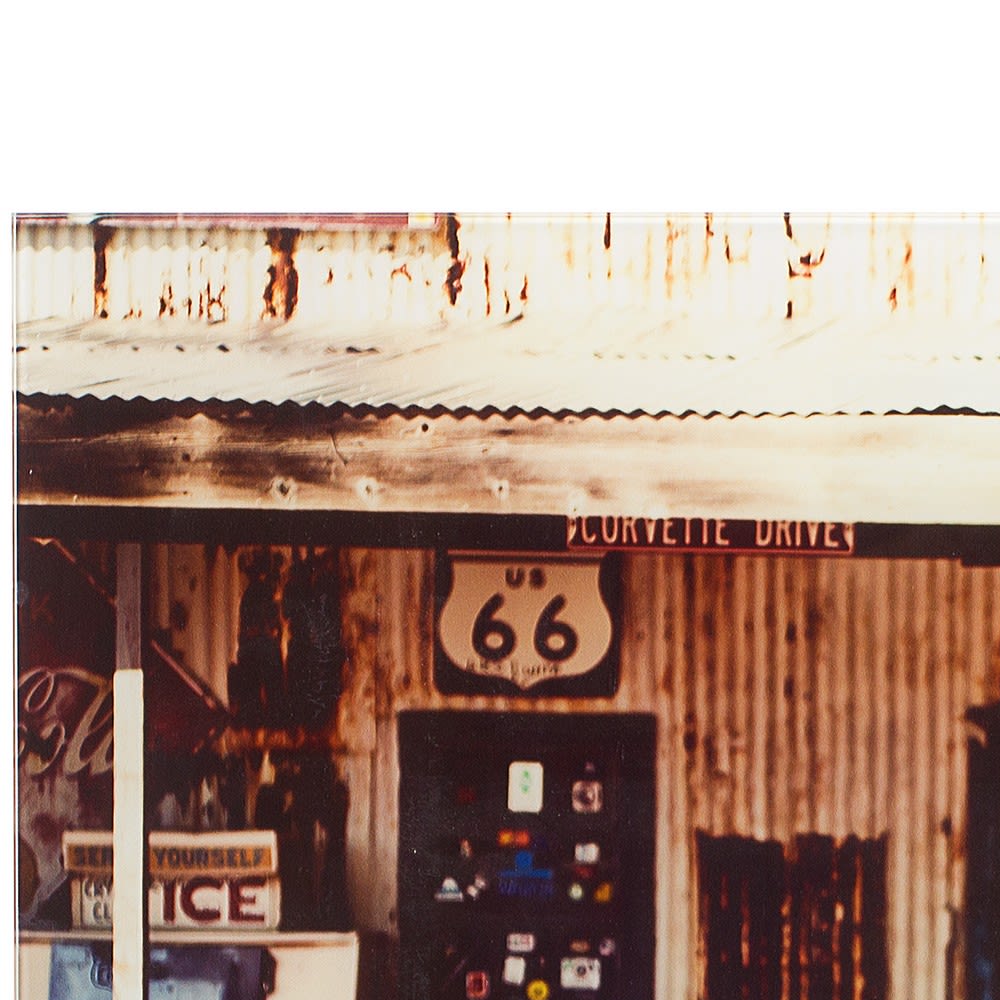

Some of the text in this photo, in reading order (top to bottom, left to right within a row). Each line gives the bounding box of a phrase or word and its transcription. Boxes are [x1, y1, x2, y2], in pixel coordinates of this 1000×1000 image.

[755, 519, 840, 547] DRIVE
[504, 566, 547, 590] US
[471, 592, 579, 662] 66
[153, 847, 265, 868] YOURSELF
[162, 874, 267, 923] ICE
